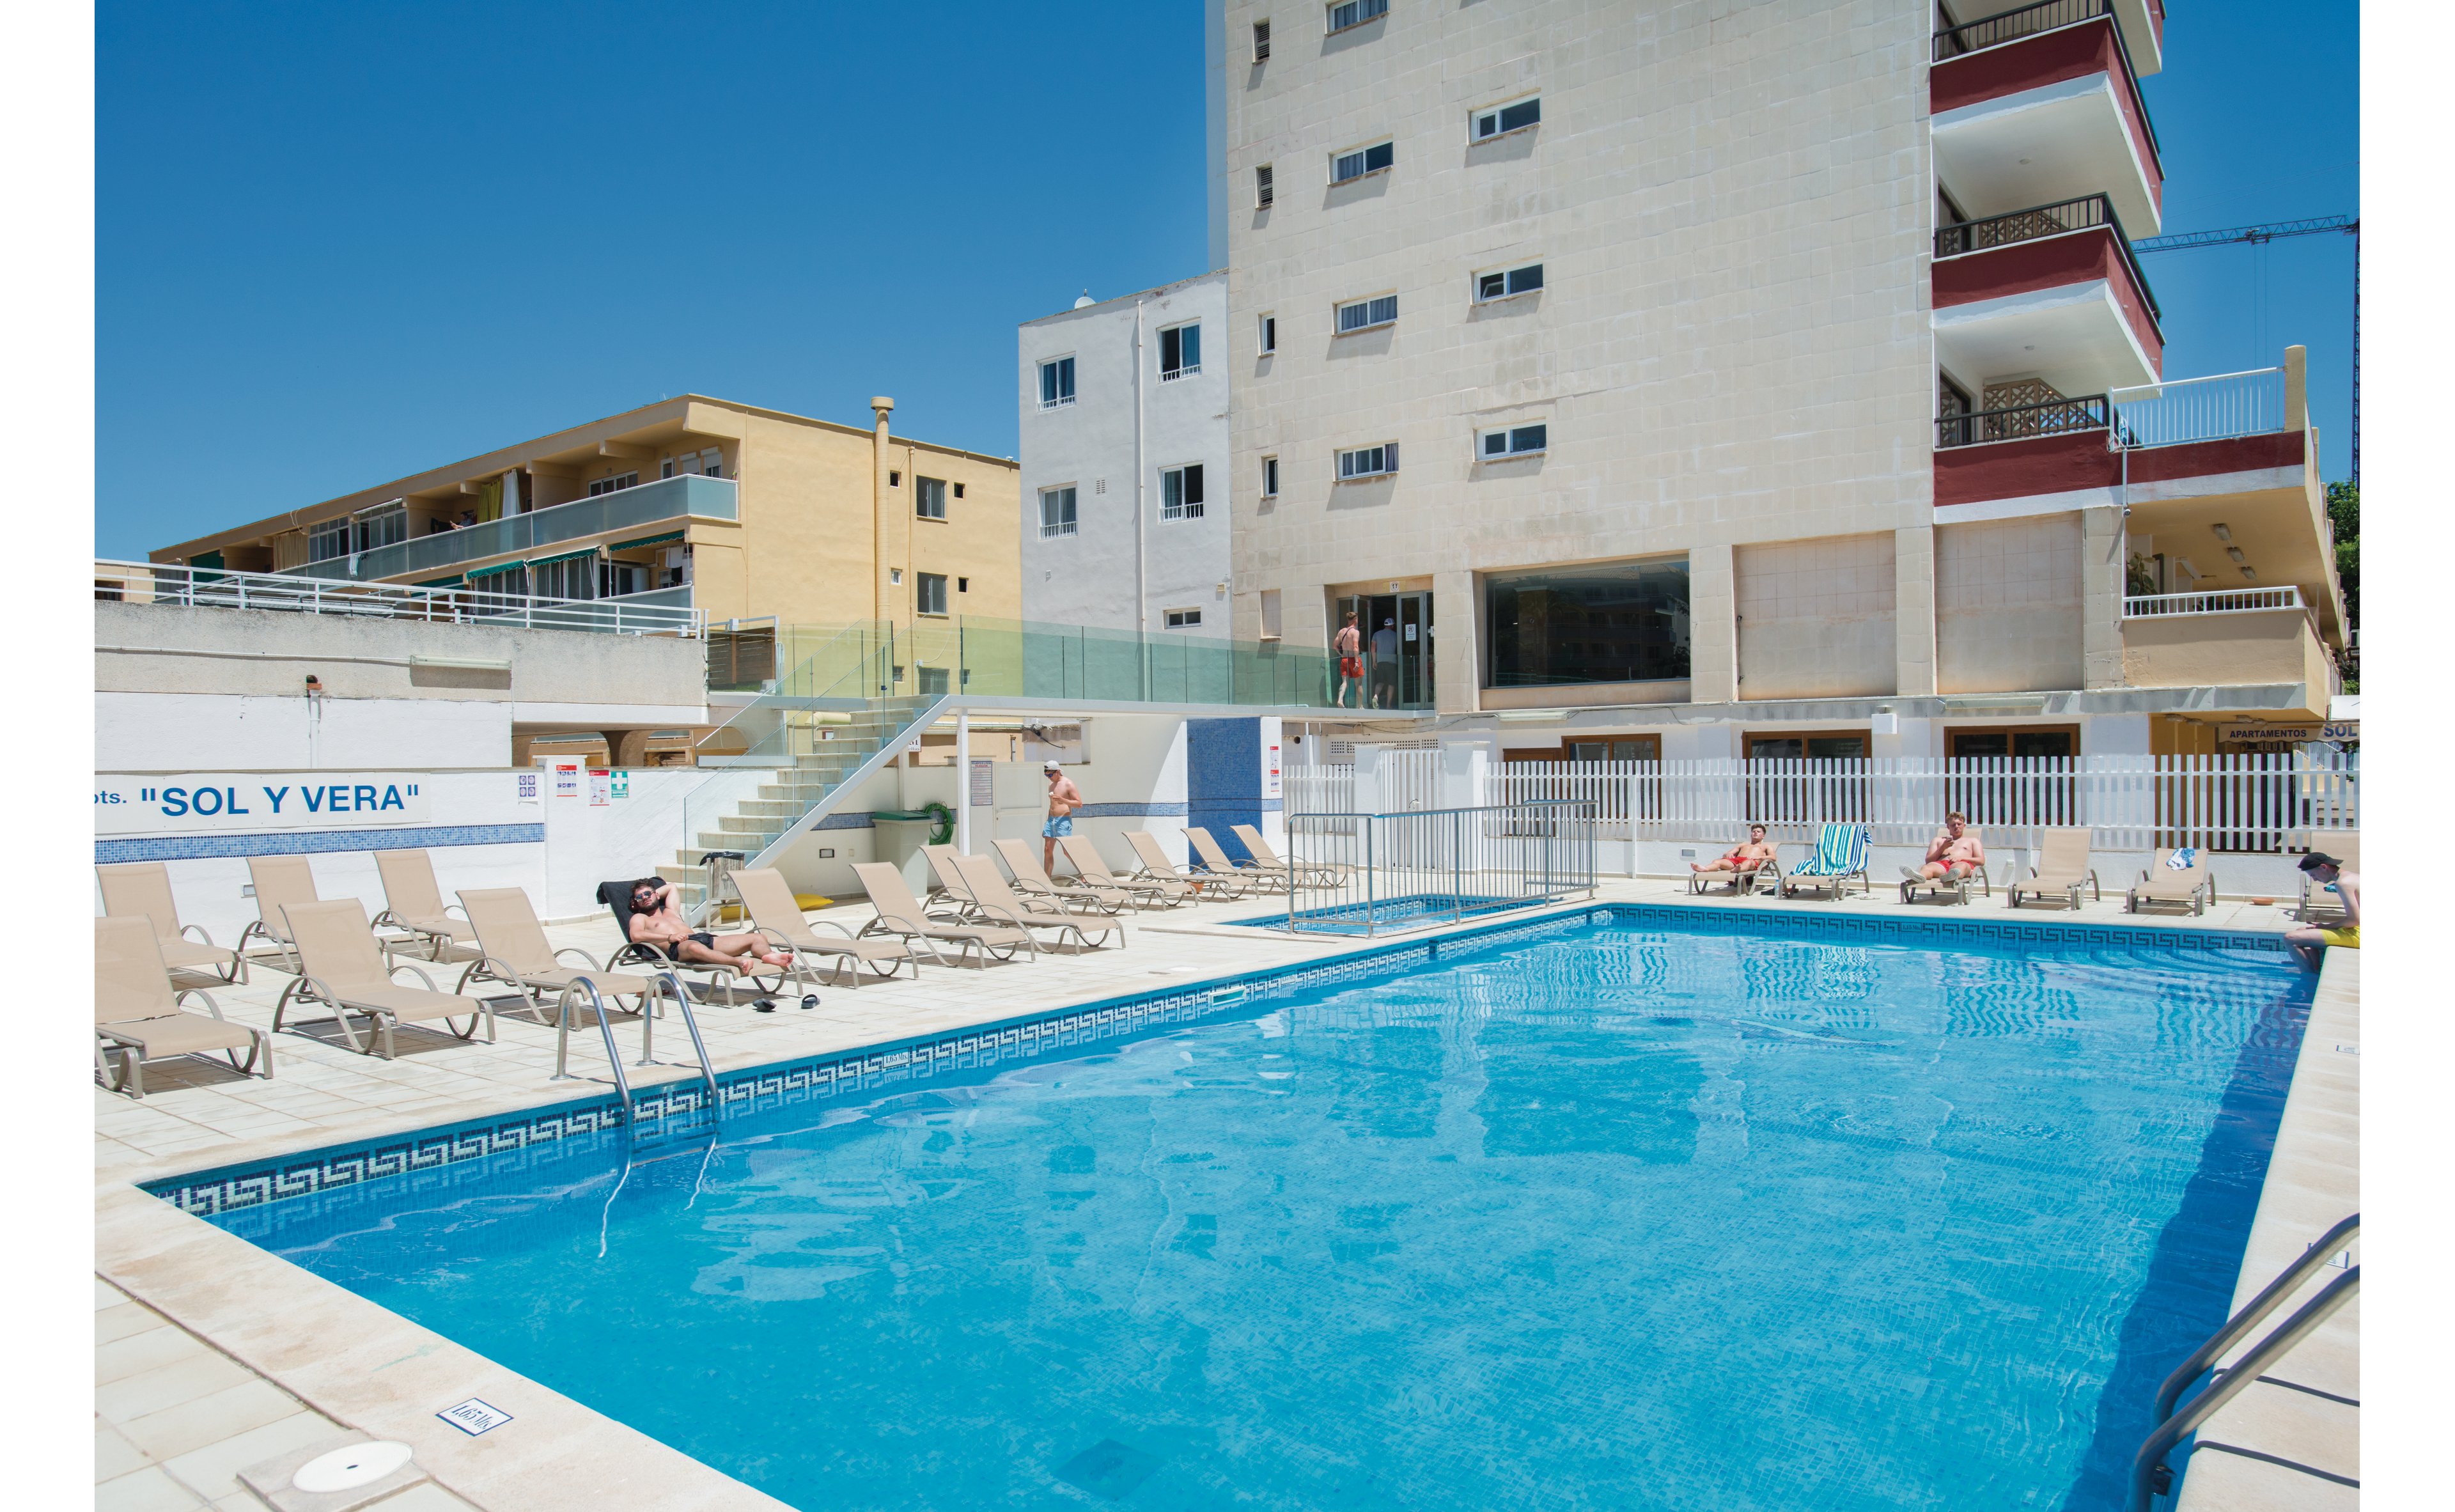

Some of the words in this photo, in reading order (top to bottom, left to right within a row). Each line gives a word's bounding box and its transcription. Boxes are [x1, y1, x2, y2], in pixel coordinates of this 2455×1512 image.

[2229, 729, 2307, 738] APARTAMENTOS
[2323, 723, 2358, 738] SOL
[141, 787, 249, 816] "SOL
[262, 786, 290, 813] Y
[300, 784, 419, 813] VERA"
[469, 1414, 494, 1430] Mts.
